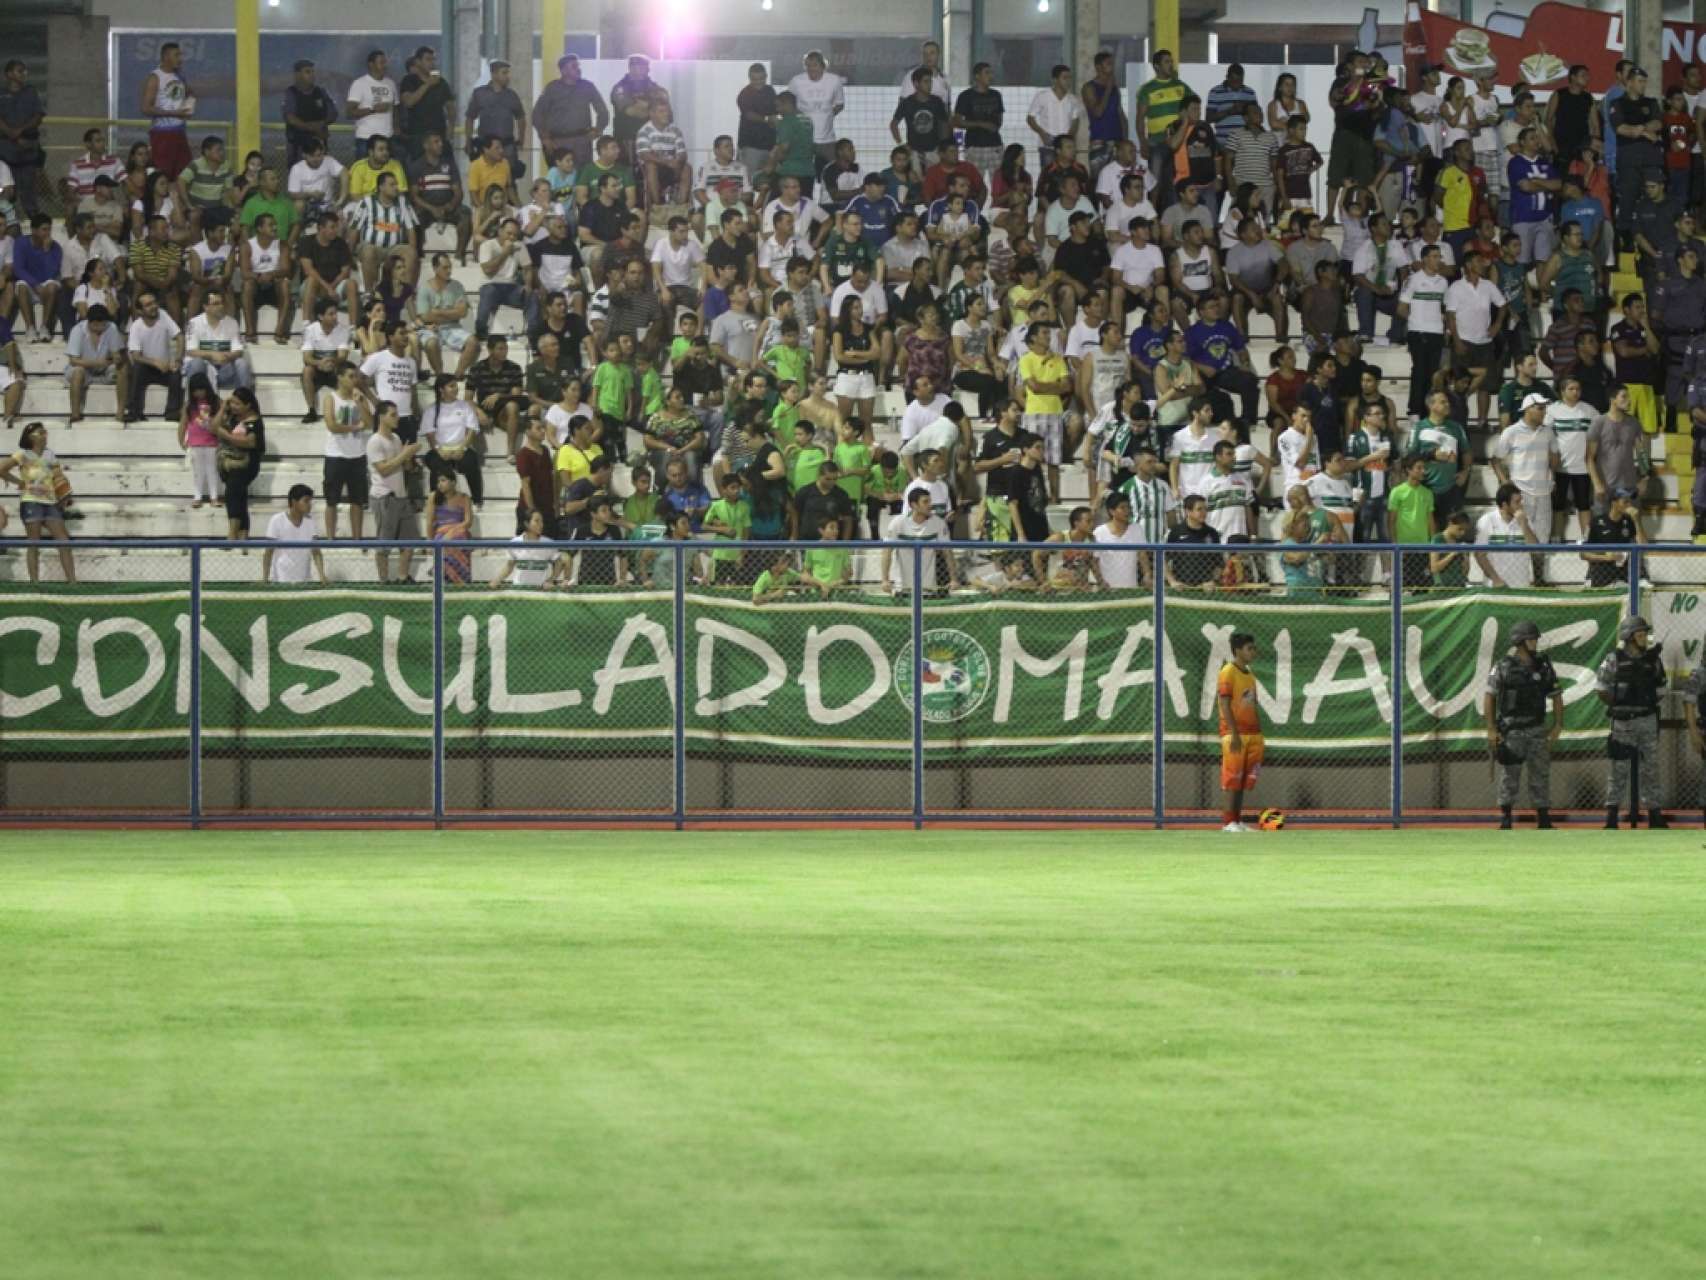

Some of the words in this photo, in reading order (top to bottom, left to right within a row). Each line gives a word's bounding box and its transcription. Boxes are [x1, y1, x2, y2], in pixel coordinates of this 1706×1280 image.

[1670, 592, 1698, 613] NO
[0, 611, 892, 725] CONSULADO
[993, 616, 1600, 725] MANAUS
